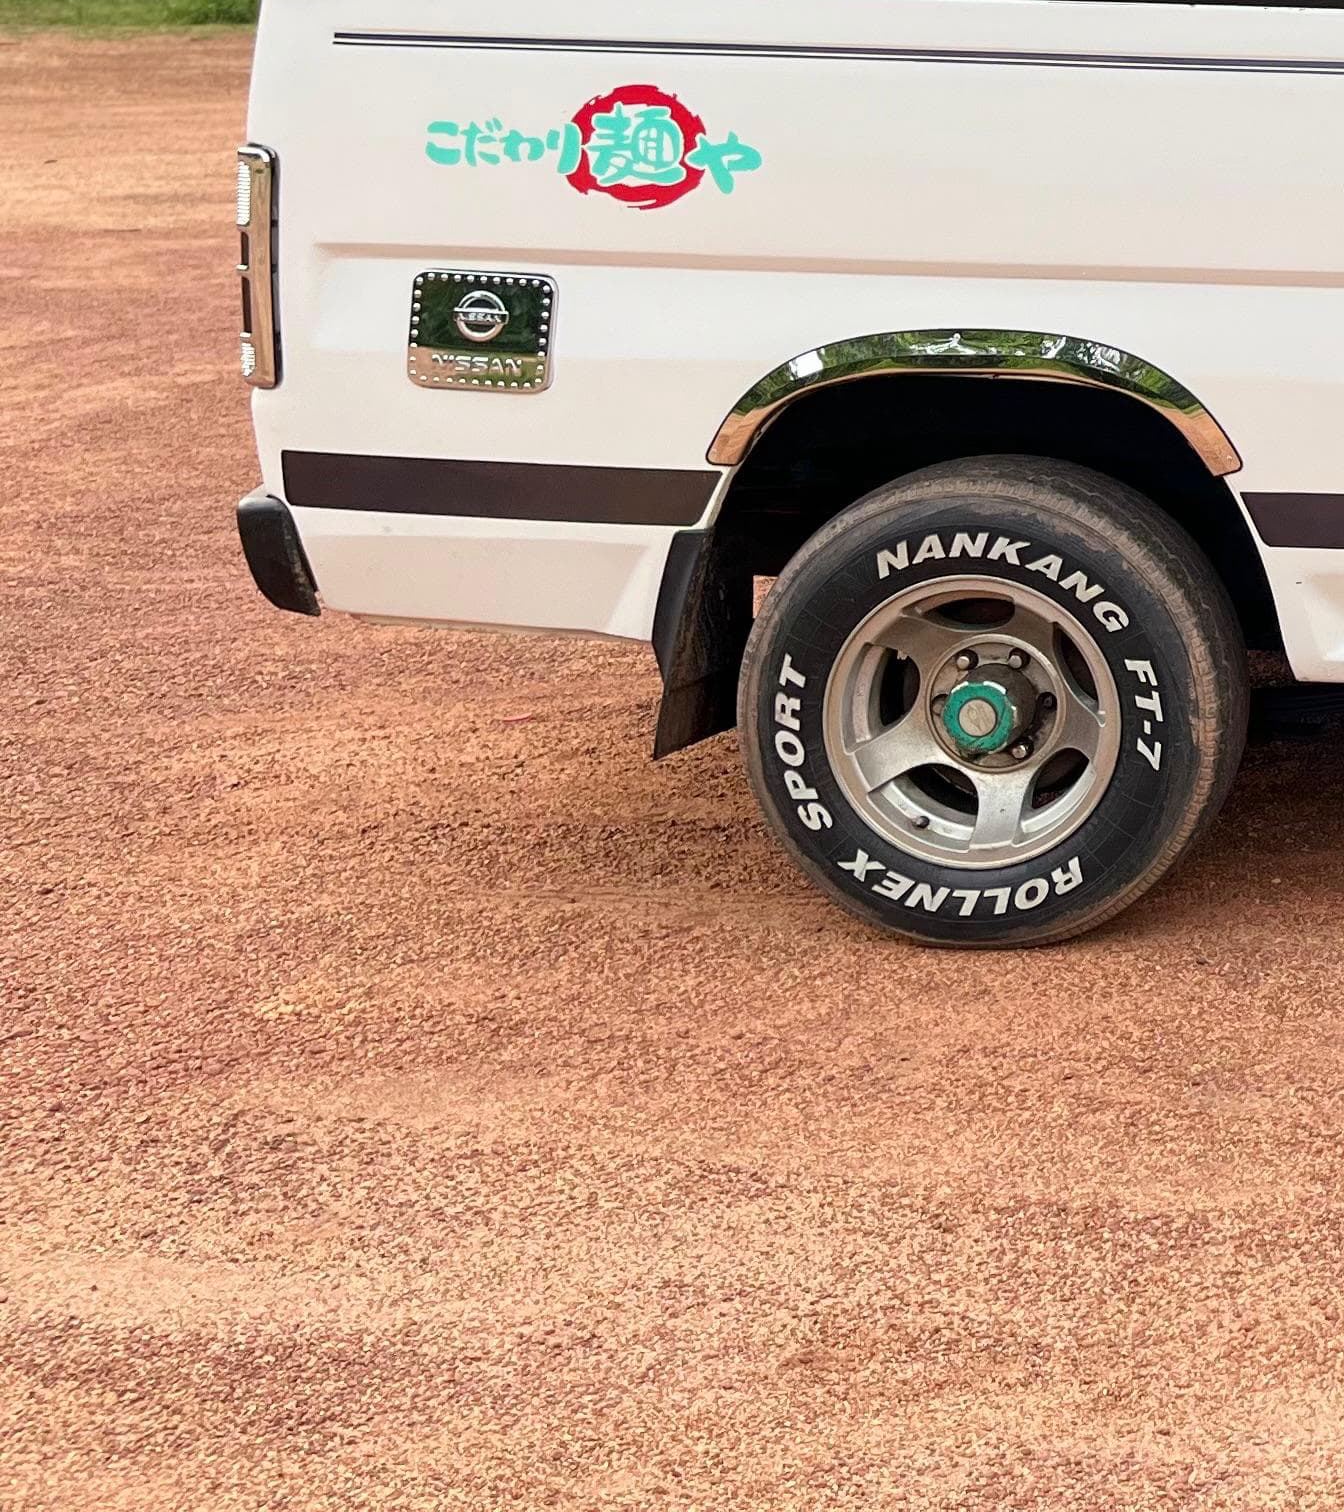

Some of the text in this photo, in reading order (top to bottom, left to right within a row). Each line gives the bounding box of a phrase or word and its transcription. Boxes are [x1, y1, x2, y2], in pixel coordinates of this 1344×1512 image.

[431, 353, 523, 377] NISSAN
[876, 532, 1165, 772] NANKANG FT-7
[774, 653, 1085, 917] ROLLNEX SPORT
